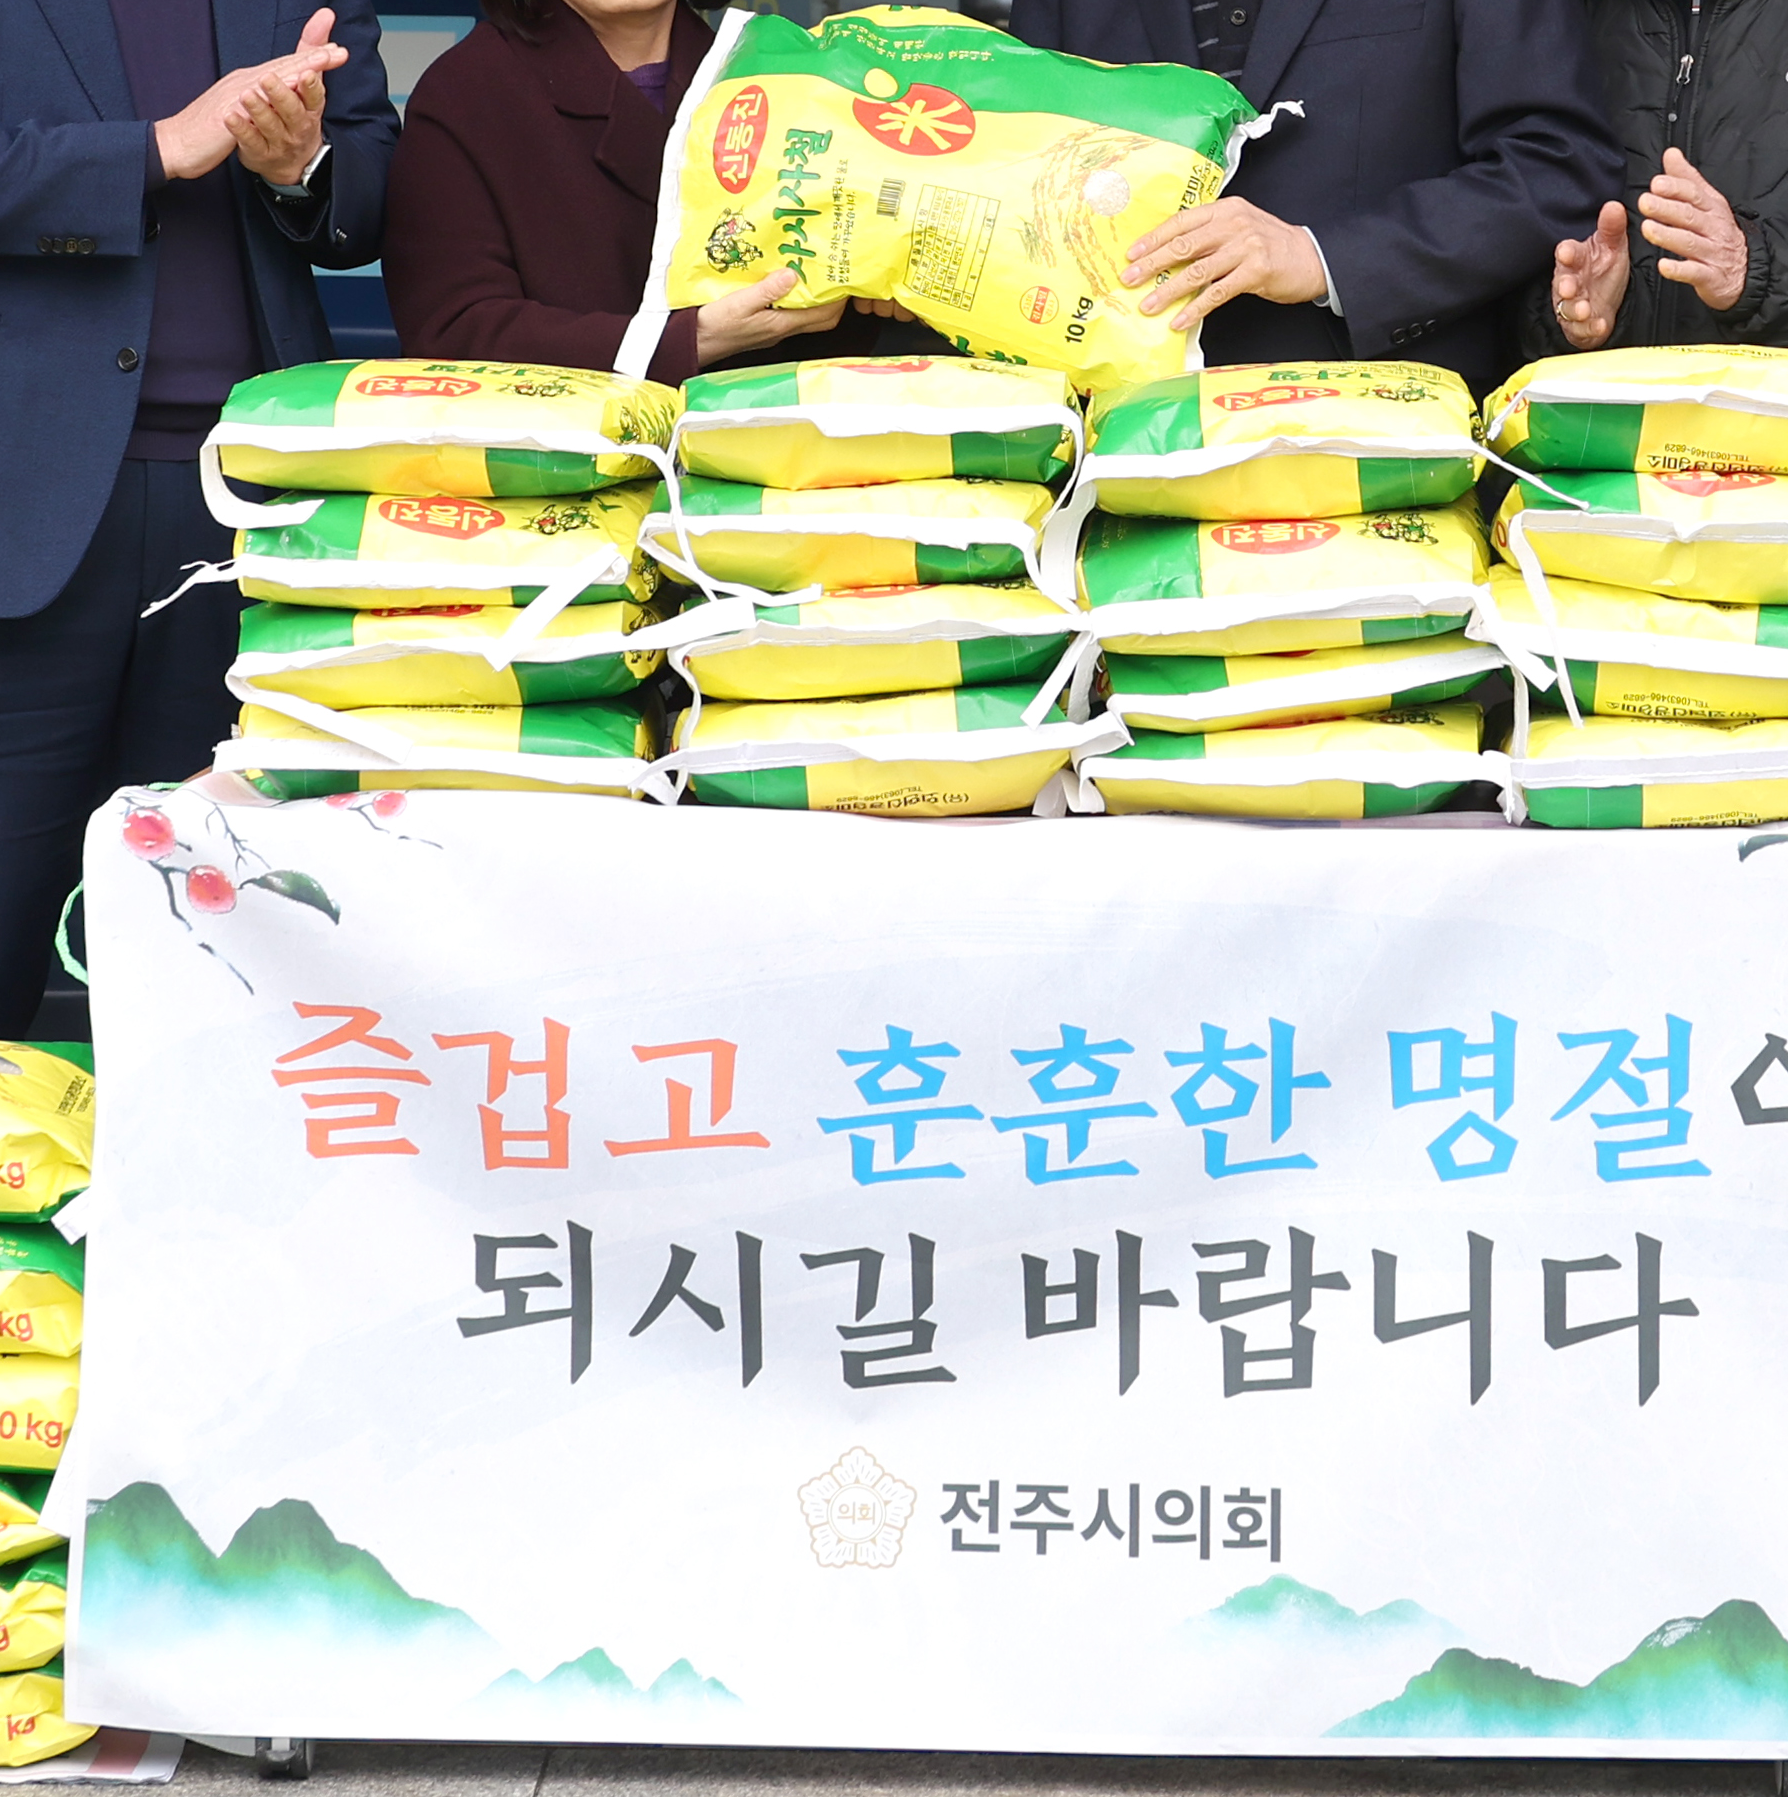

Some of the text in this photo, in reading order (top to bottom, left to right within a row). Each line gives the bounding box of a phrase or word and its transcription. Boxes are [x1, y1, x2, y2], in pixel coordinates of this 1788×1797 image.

[722, 92, 764, 185] 신동진
[773, 128, 833, 285] 사시사철
[1065, 296, 1094, 344] 10 kg
[388, 497, 502, 532] 신동진
[1223, 520, 1331, 546] 신동진
[274, 1003, 769, 1170] 즐겁고
[817, 1018, 1331, 1186] 훈훈한
[0, 1313, 33, 1341] kg
[457, 1220, 1699, 1406] 되시길 바랍니다
[27, 1415, 62, 1448] kg
[837, 1501, 876, 1525] 의회
[941, 1480, 1281, 1562] 전주시의회
